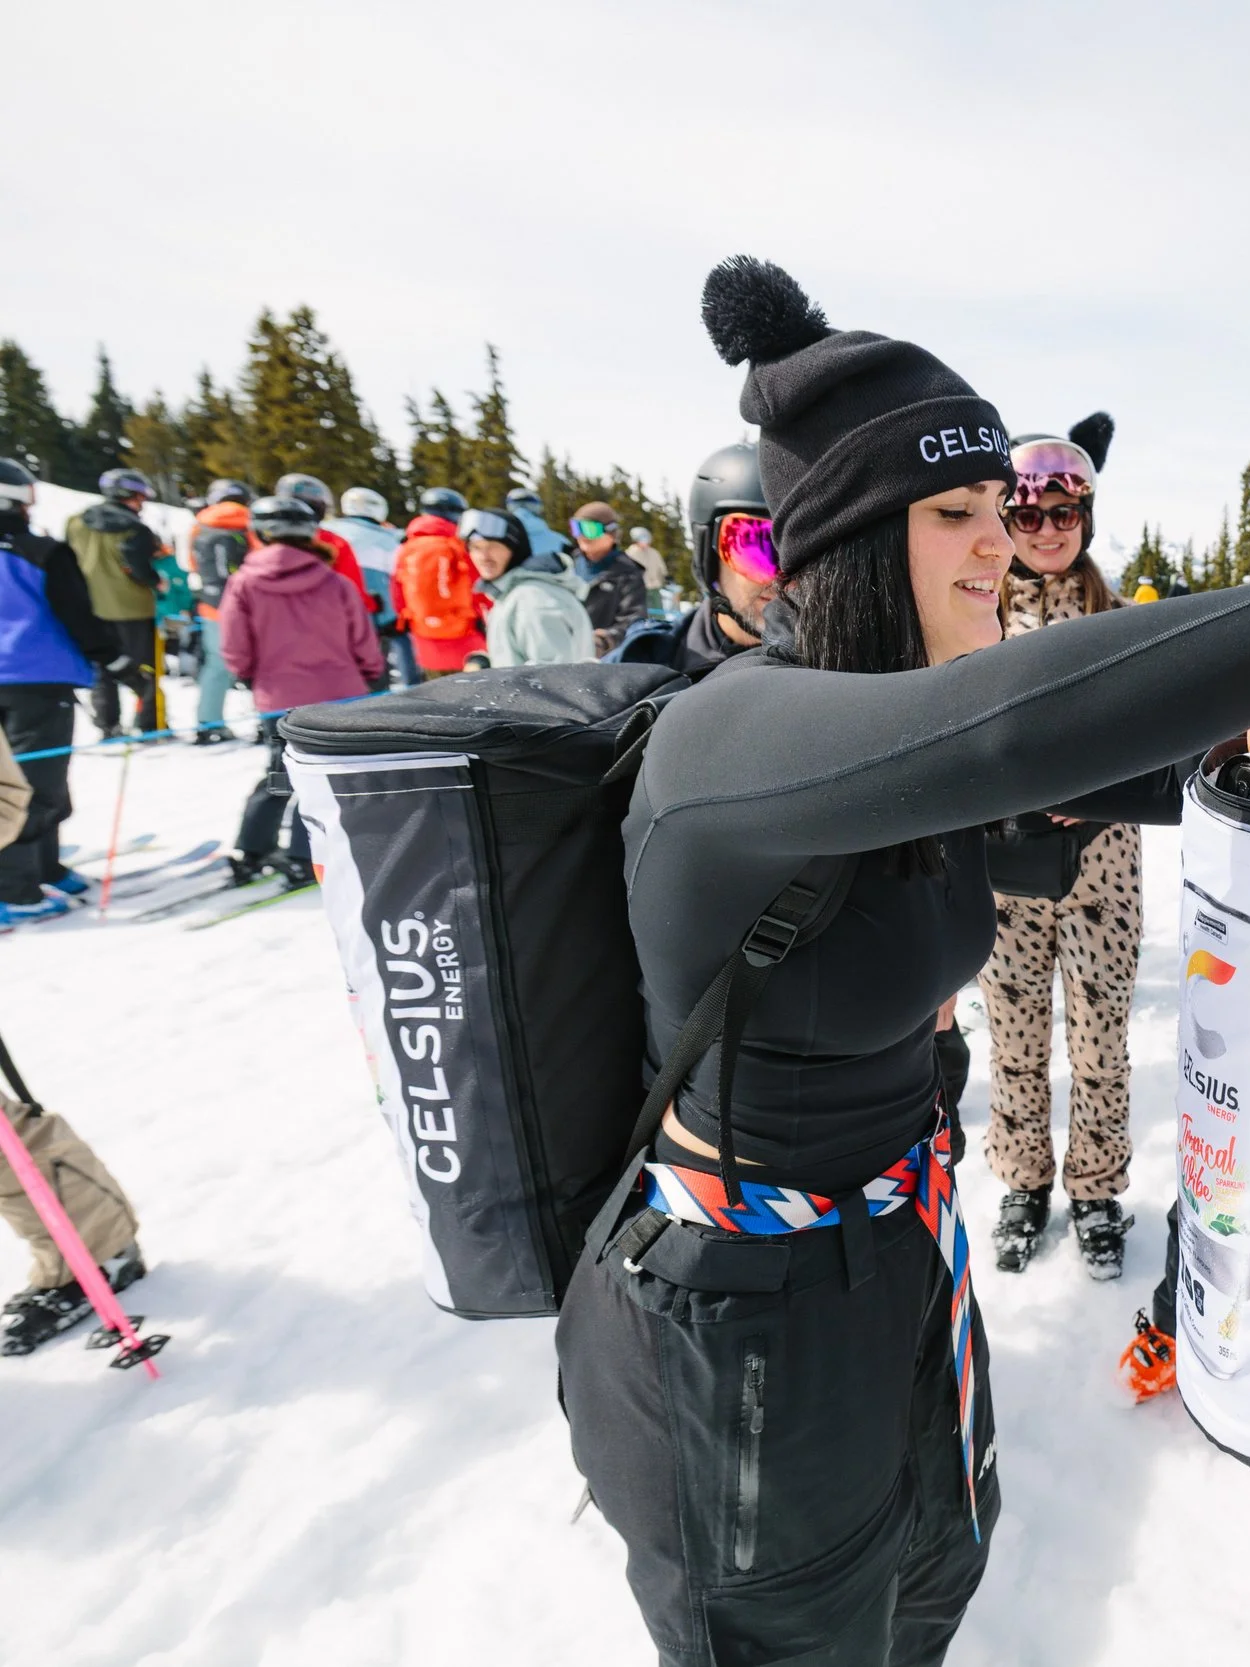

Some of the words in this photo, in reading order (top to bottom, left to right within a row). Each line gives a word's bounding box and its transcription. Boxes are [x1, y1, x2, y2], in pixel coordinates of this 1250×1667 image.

[432, 918, 464, 1020] ENERGY
[1207, 1102, 1237, 1123] ENERGY
[1182, 1113, 1236, 1176] Tropical
[1183, 1154, 1213, 1202] Vibe
